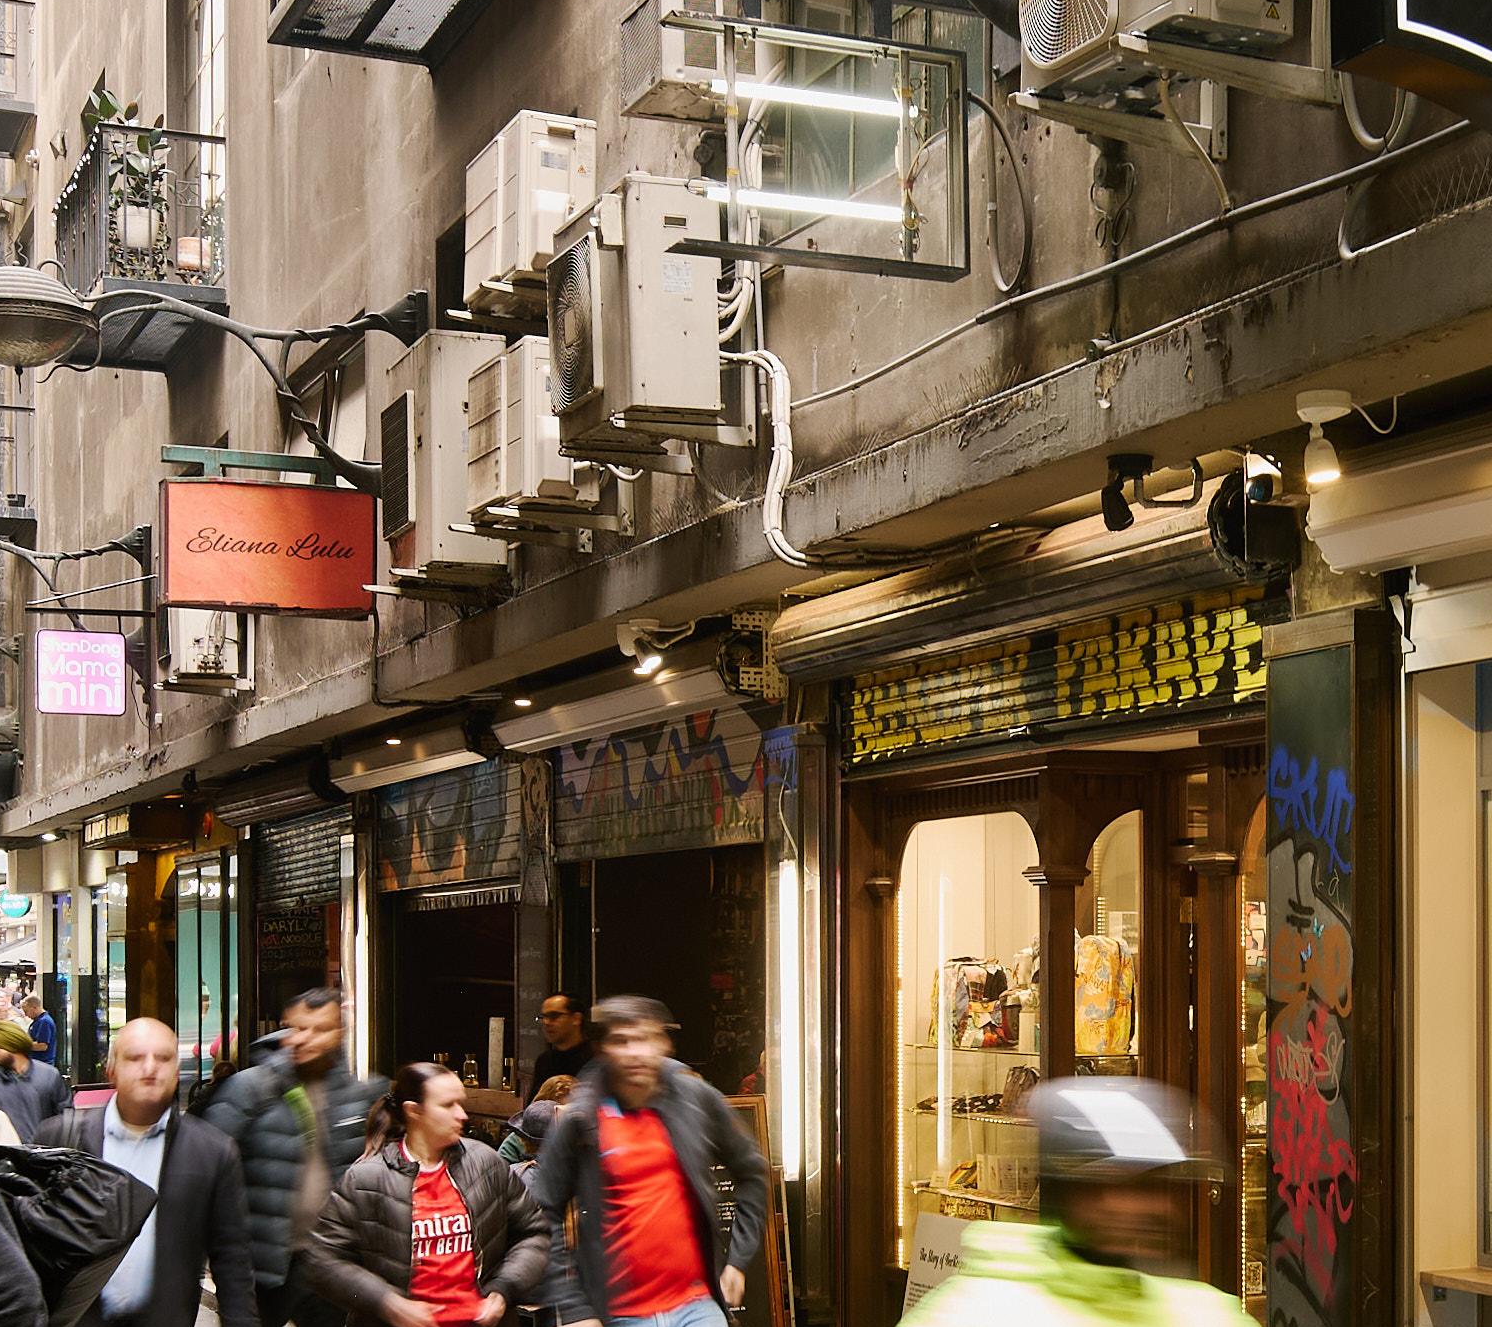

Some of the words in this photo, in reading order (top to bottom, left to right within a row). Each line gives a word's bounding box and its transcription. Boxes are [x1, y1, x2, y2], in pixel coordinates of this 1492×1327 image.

[186, 526, 282, 559] Eliana
[43, 654, 121, 677] Mama
[42, 677, 120, 706] mini
